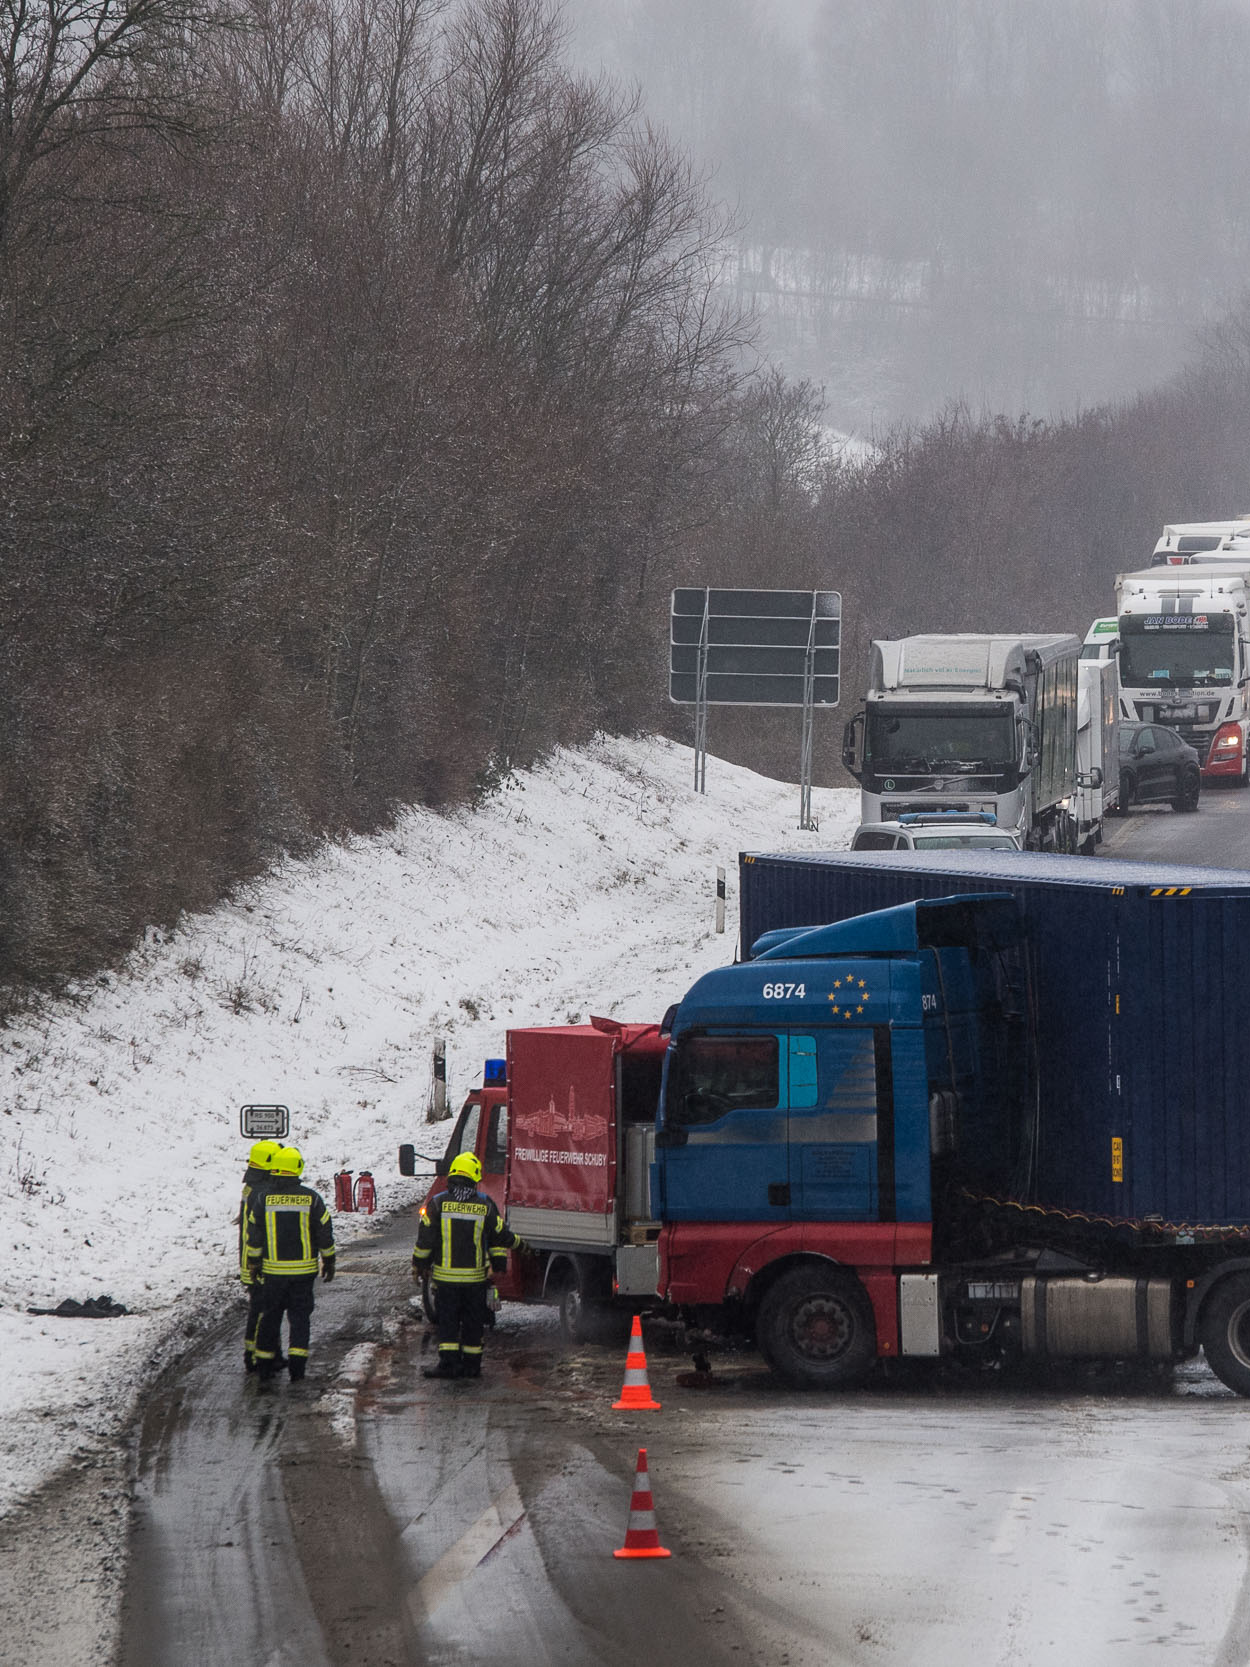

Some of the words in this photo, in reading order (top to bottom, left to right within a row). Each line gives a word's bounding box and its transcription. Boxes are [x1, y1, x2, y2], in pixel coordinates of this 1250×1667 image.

[1144, 616, 1164, 624] JAN
[1165, 616, 1193, 624] BODE
[762, 983, 806, 999] 6874
[515, 1147, 549, 1162] FREIWILLIGE
[549, 1150, 584, 1165] FEUERWEHR
[584, 1153, 607, 1166] SCHUBY
[267, 1195, 311, 1205] FEUERWEHR
[443, 1201, 486, 1214] FEUERWEHR
